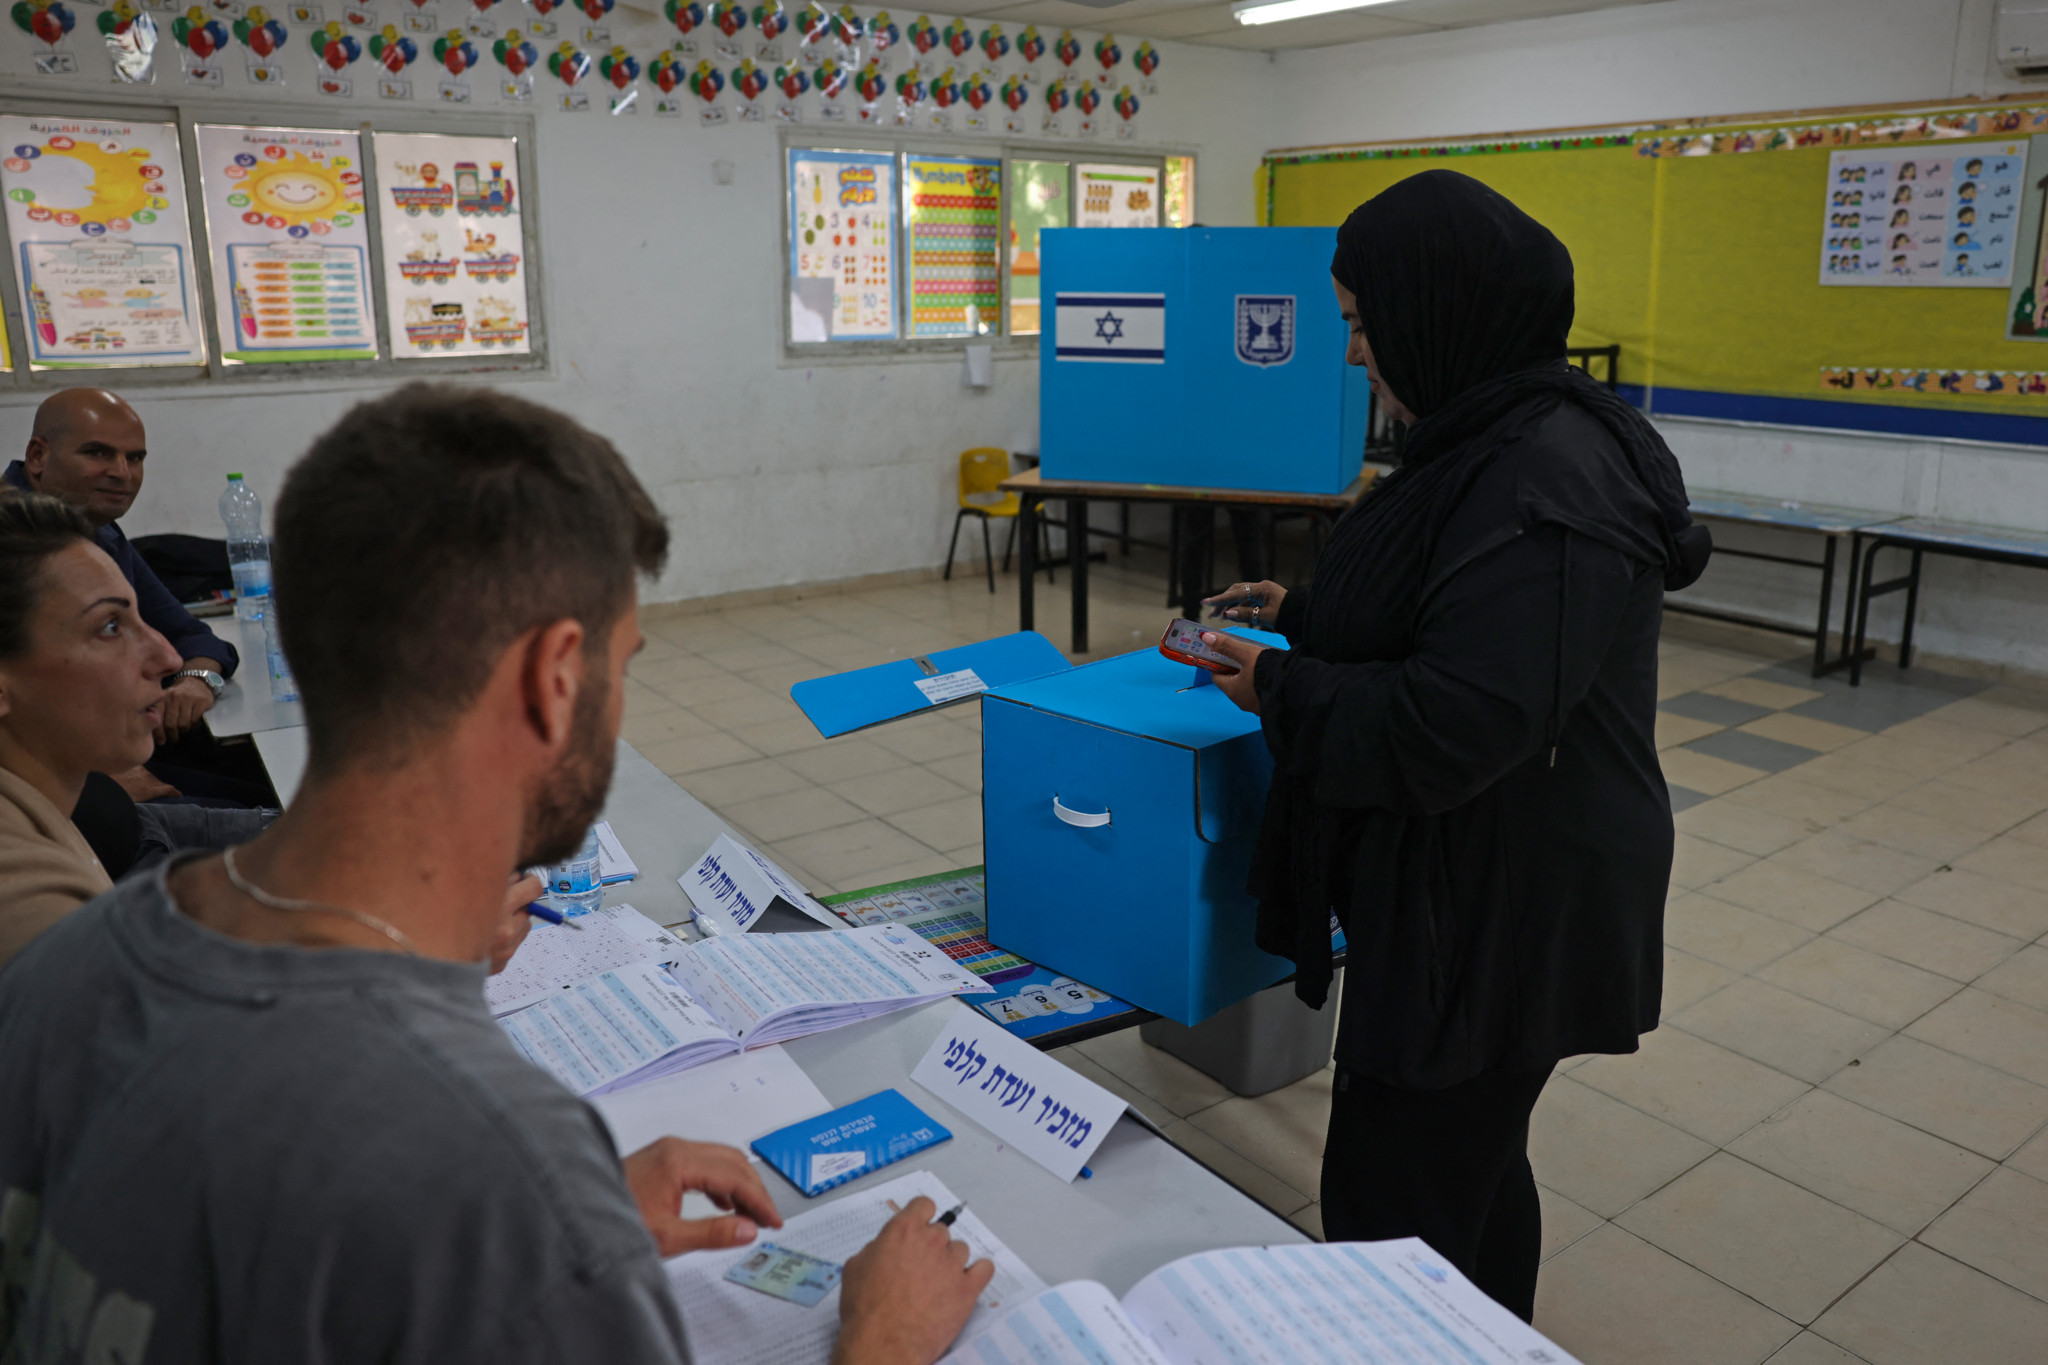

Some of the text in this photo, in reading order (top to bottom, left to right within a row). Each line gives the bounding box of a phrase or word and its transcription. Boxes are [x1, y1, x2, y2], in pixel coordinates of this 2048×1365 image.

[1994, 161, 2009, 174] هو
[913, 167, 966, 185] Numbers
[800, 214, 808, 228] 2
[831, 214, 839, 228] 3
[862, 214, 870, 228] 4
[801, 256, 809, 270] 5
[832, 256, 840, 270] 6
[697, 854, 756, 926] מזכיר ועדת קלפי
[1034, 995, 1048, 1003] 6
[1067, 990, 1084, 1000] 5
[1002, 1004, 1013, 1013] 7
[943, 1036, 1092, 1149] מזכיר ועדת קלפי
[809, 1114, 876, 1144] הבחירות לכנסת
[841, 1122, 877, 1139] העשרים
